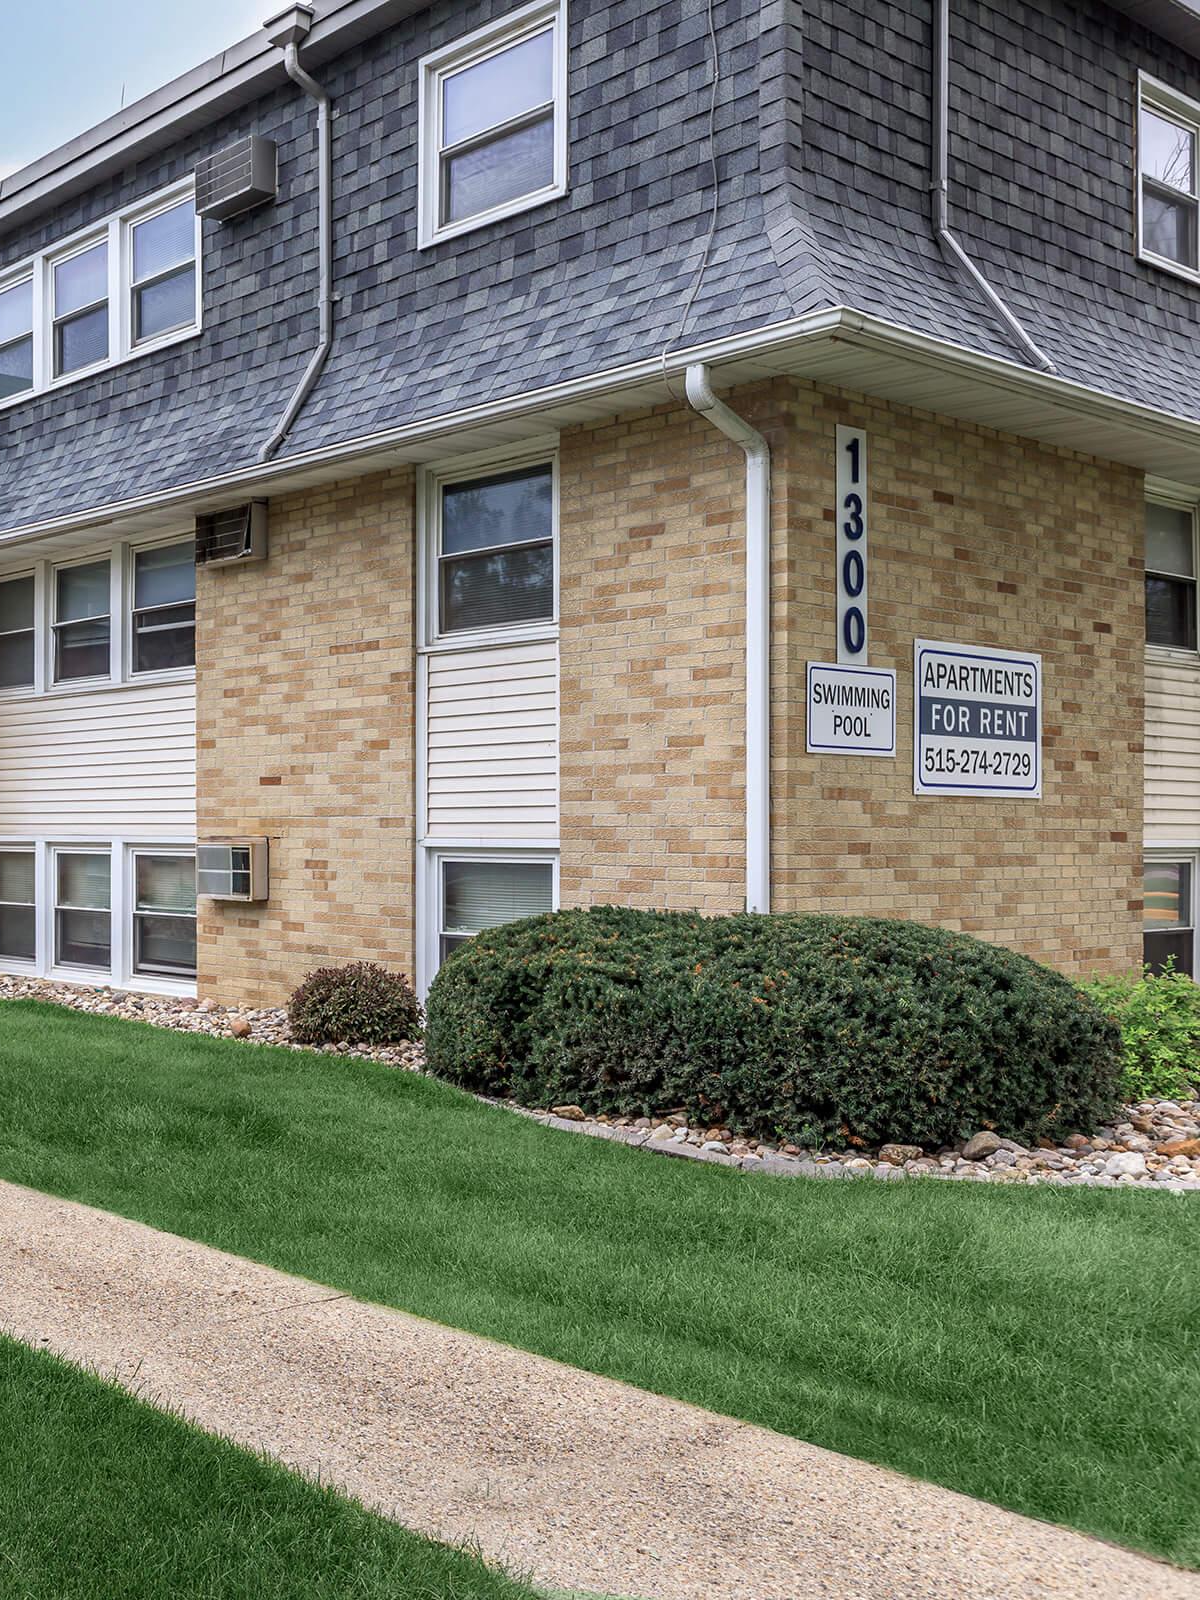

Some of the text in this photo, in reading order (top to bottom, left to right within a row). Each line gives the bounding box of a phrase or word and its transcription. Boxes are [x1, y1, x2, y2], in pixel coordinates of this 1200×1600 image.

[843, 438, 865, 654] 1300
[924, 661, 1033, 698] APARTMENTS
[813, 683, 890, 710] SWIMMING
[833, 714, 871, 738] POOL
[931, 703, 1029, 737] FOR RENT
[924, 747, 1031, 777] 515-274-2729
